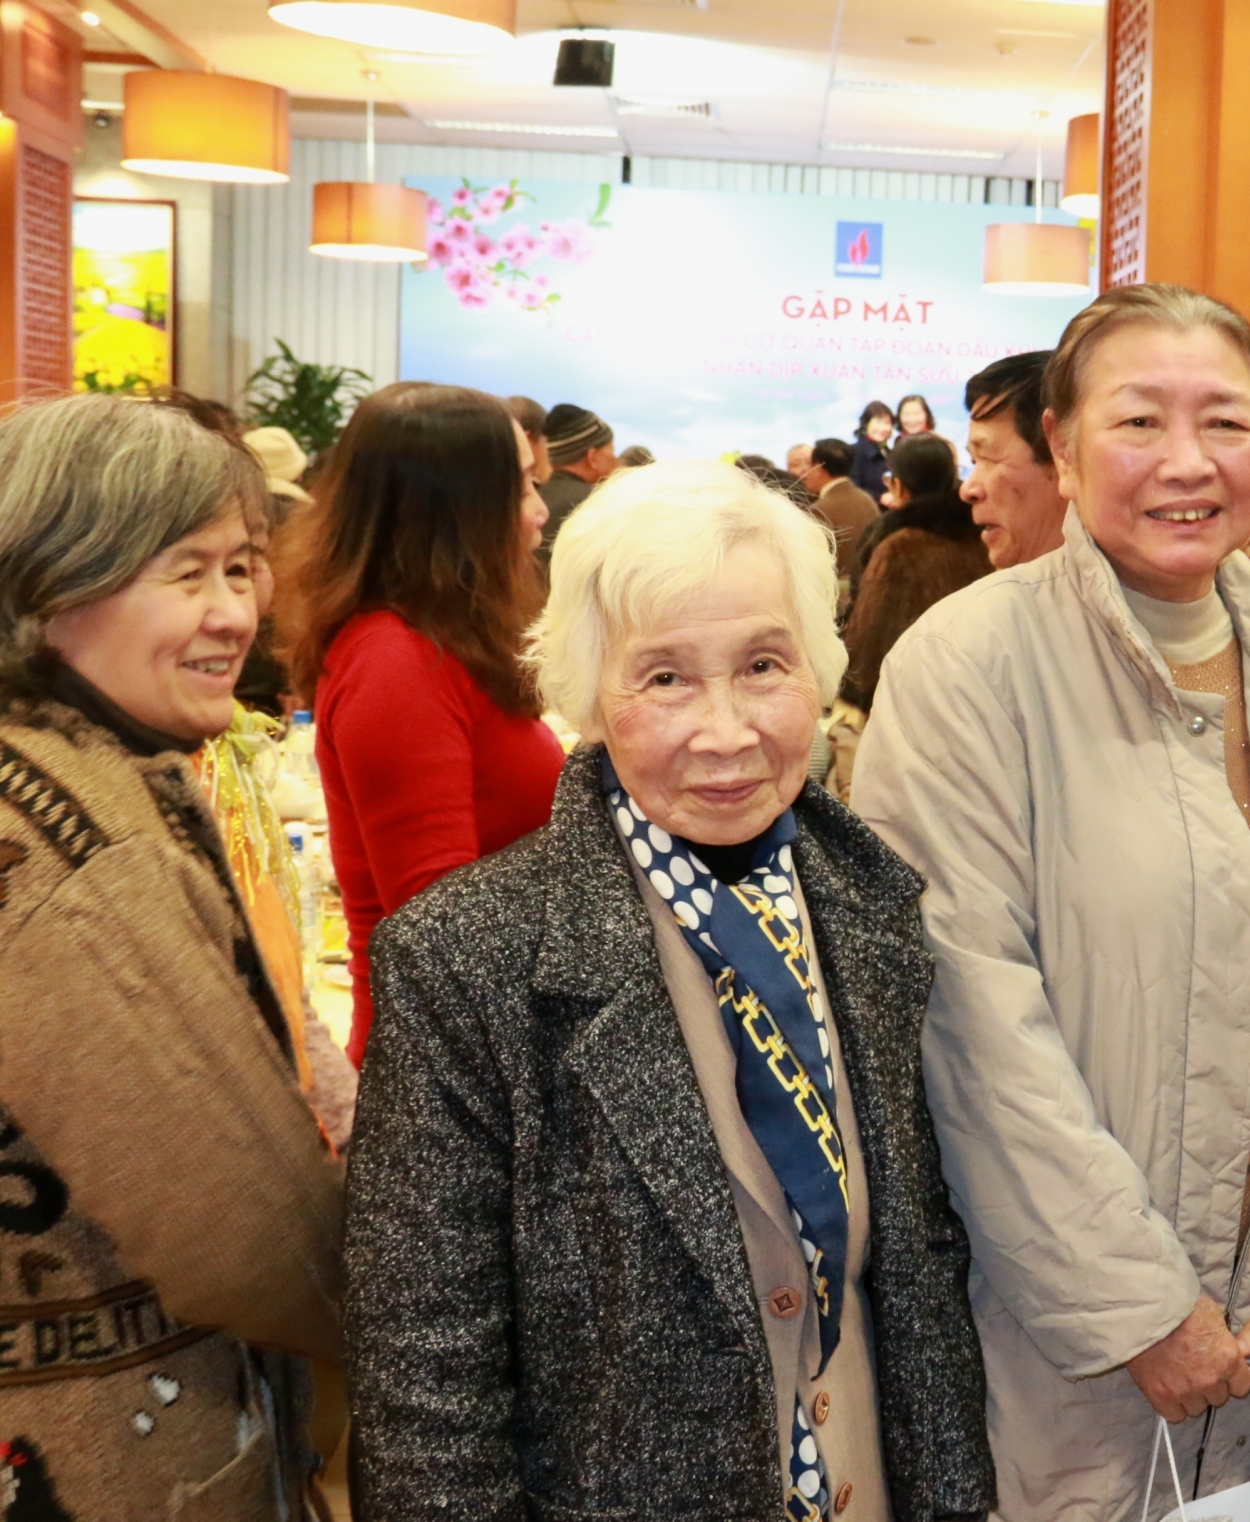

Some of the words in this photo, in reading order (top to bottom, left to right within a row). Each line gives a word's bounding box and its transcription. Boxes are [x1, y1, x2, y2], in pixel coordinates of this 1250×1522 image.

[782, 290, 852, 328] GẶP
[863, 294, 934, 331] MẶT
[744, 332, 776, 349] CƠ
[782, 335, 843, 351] QUAN
[810, 360, 866, 381] XUÂN
